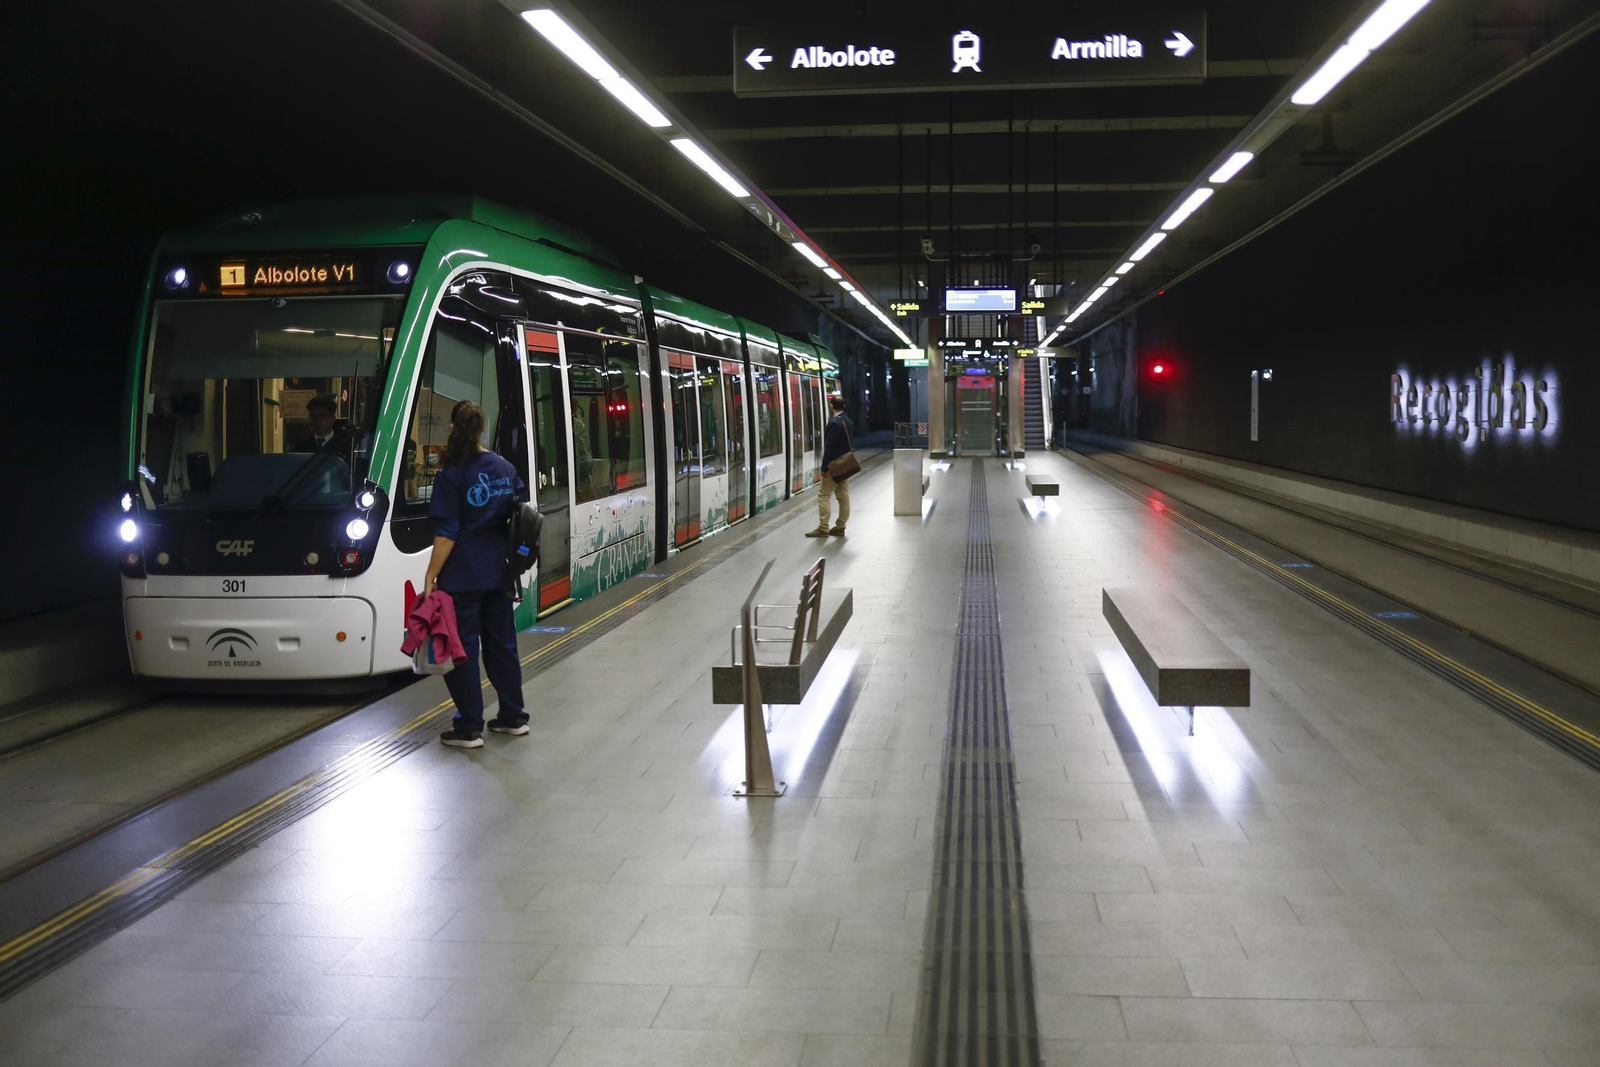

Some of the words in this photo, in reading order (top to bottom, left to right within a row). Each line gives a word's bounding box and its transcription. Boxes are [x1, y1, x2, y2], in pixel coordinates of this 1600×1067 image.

[790, 44, 896, 69] Albolote
[1050, 33, 1144, 60] Armilla
[254, 265, 328, 284] Albolote
[332, 264, 354, 281] V1
[897, 302, 919, 310] Salida
[1390, 363, 1549, 443] Recogidas
[216, 540, 255, 557] CAF
[222, 579, 247, 593] 301
